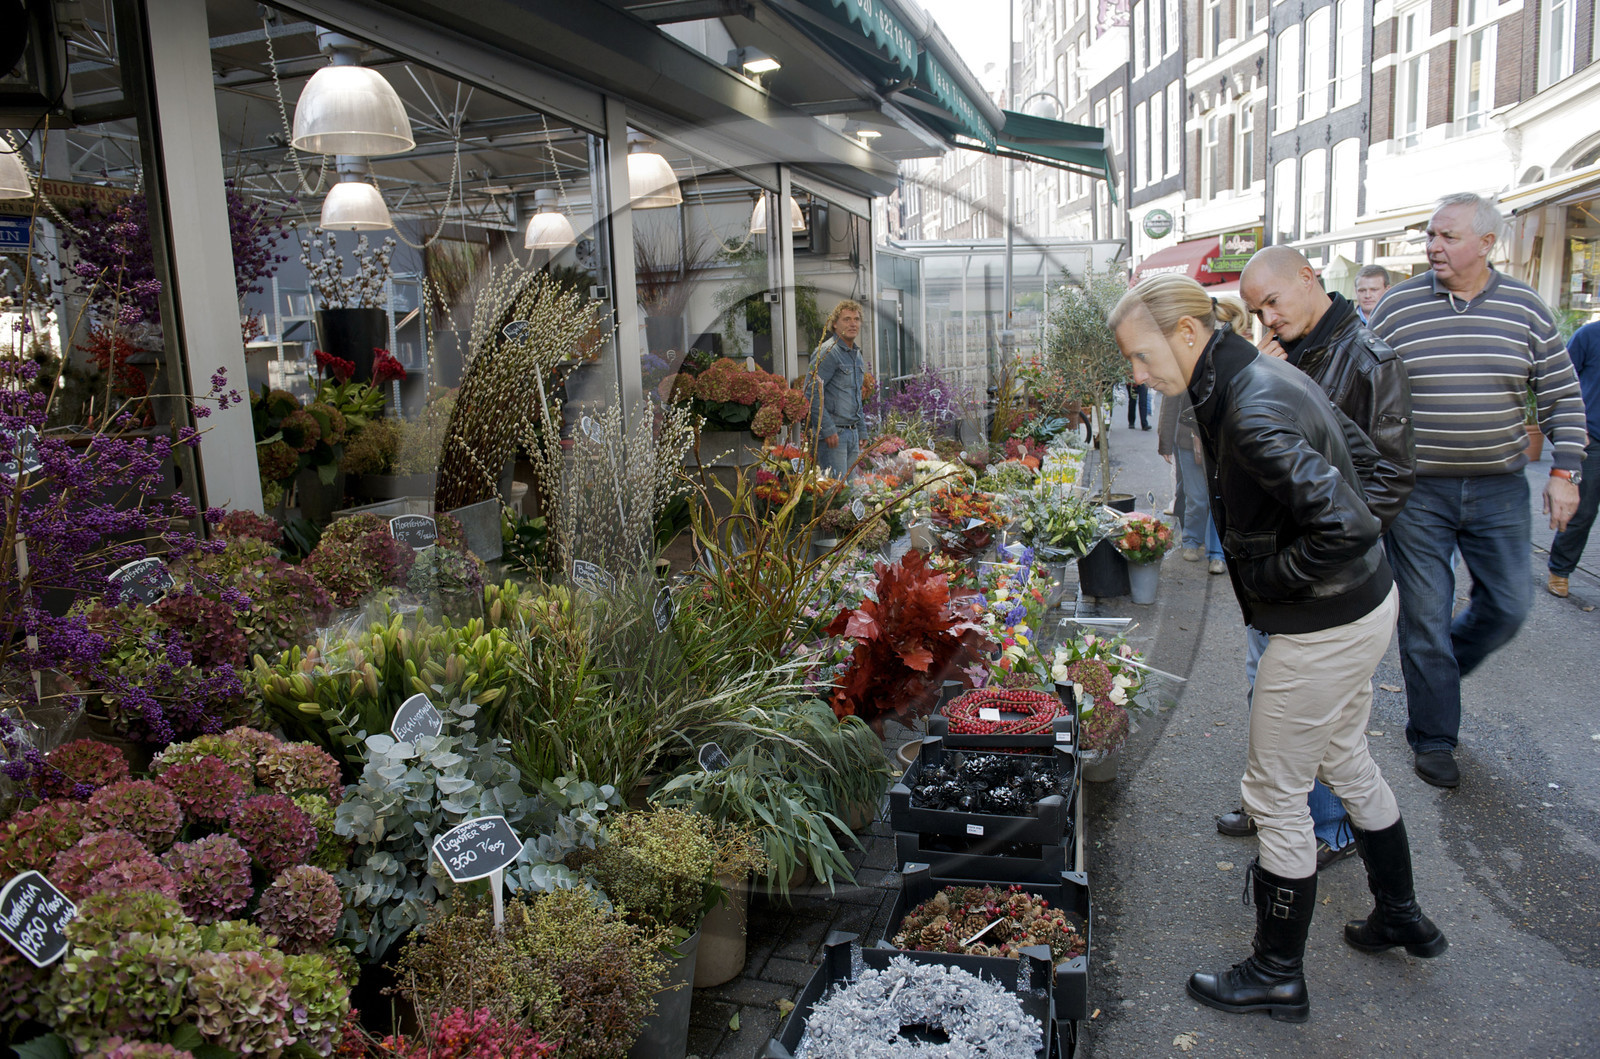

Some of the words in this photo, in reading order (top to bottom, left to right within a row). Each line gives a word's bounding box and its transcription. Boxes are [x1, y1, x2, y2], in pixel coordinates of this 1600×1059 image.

[880, 9, 894, 39] 622
[952, 85, 974, 121] Timmer
[121, 561, 154, 583] RTENSIA
[479, 821, 496, 831] BES
